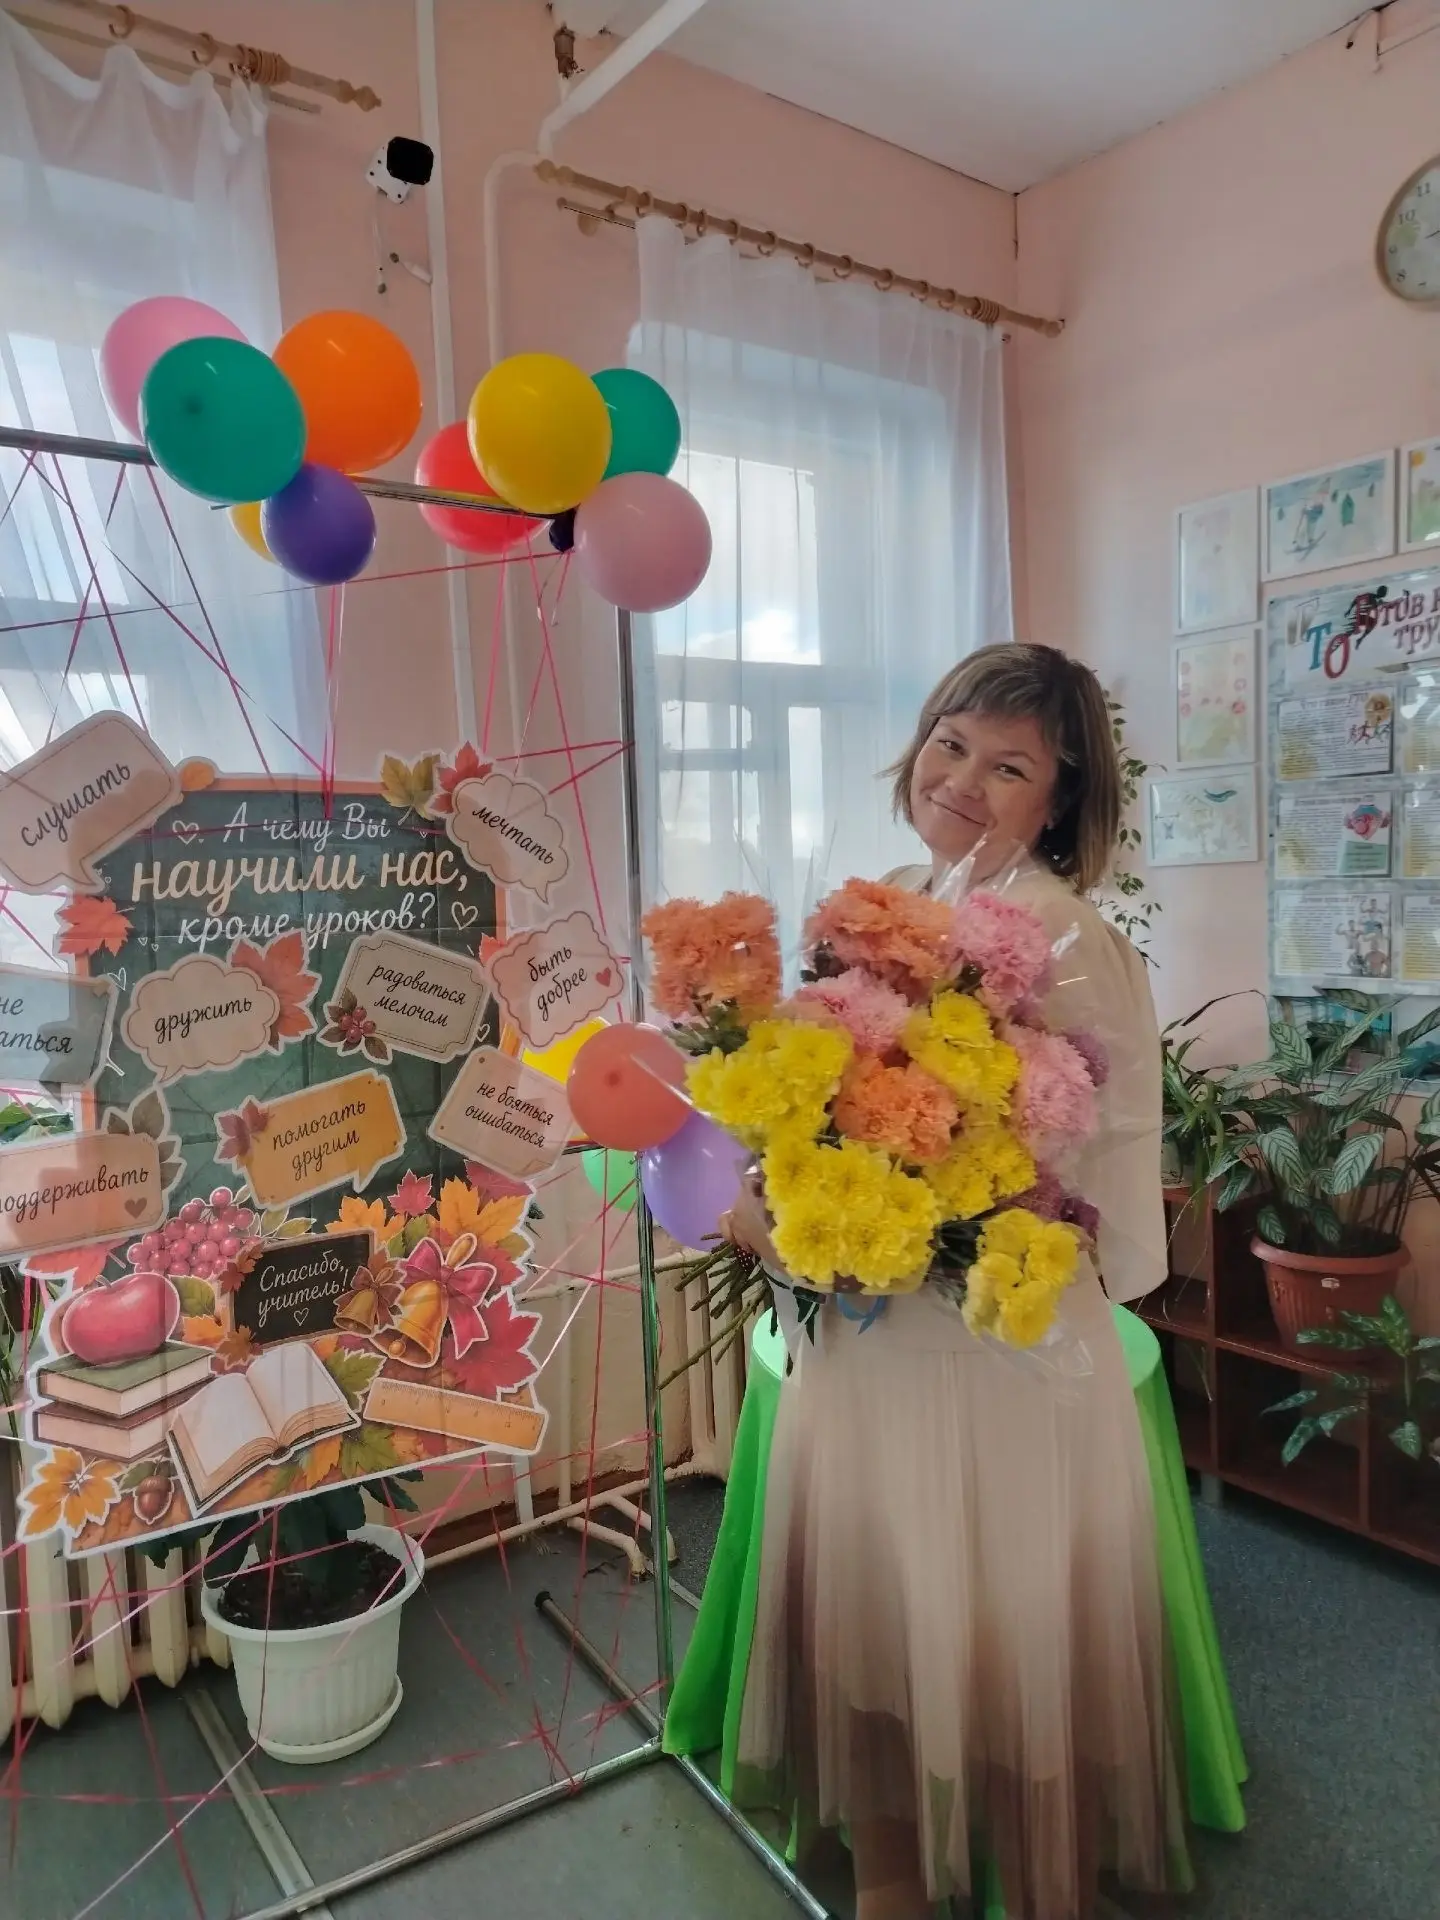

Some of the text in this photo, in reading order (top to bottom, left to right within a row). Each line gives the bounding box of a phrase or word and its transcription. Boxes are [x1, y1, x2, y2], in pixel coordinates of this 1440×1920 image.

[1393, 614, 1440, 655] тру
[21, 762, 131, 847] слушать
[223, 801, 390, 852] А чему Вы
[471, 805, 554, 865] мечтать
[132, 849, 468, 917] научили нас,
[178, 892, 436, 955] кроме уроков?
[367, 963, 467, 1005] радоваться
[526, 946, 572, 982] быть
[373, 994, 448, 1027] мелочам
[536, 968, 588, 1021] добрее
[0, 1030, 73, 1054] аться
[155, 998, 252, 1045] дружить
[272, 1101, 367, 1151] помогать
[465, 1105, 546, 1148] ошибаться
[477, 1081, 554, 1127] не бояться
[291, 1135, 361, 1181] другим
[260, 1249, 344, 1292] Спасибо,
[258, 1269, 349, 1328] учитель!
